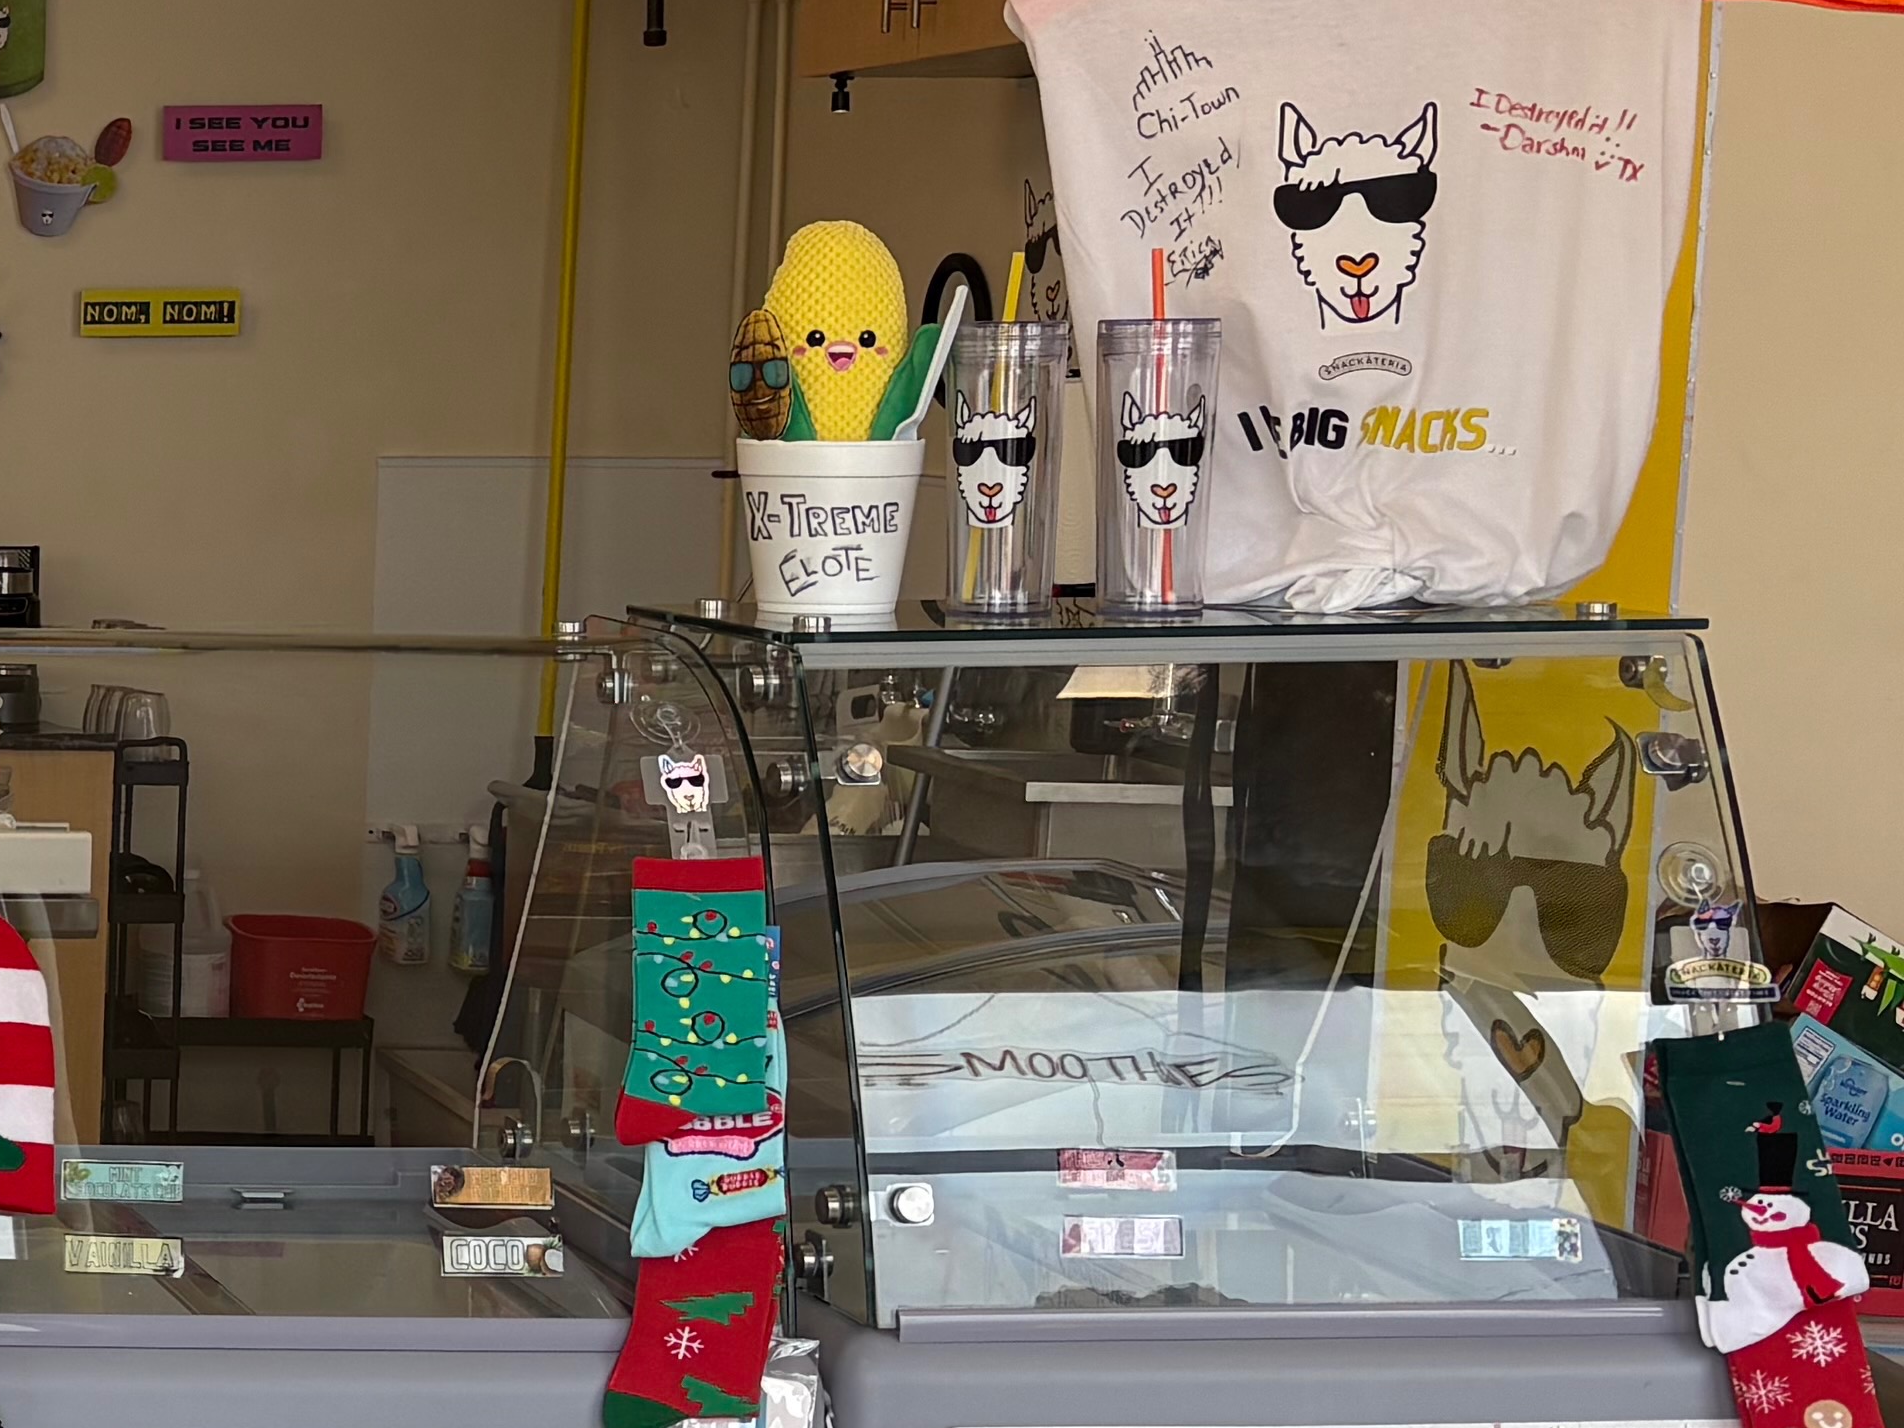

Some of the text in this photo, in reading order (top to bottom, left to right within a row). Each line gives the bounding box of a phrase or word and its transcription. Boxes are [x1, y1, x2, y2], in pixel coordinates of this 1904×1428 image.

[189, 116, 242, 131] SEE
[249, 115, 312, 131] YOU
[1136, 86, 1241, 139] Chi-Town
[191, 138, 293, 154] SEE ME
[84, 301, 234, 325] NOM, NOM!
[778, 544, 881, 599] ELOTE
[1823, 1105, 1860, 1128] Water
[450, 1238, 526, 1272] COCO
